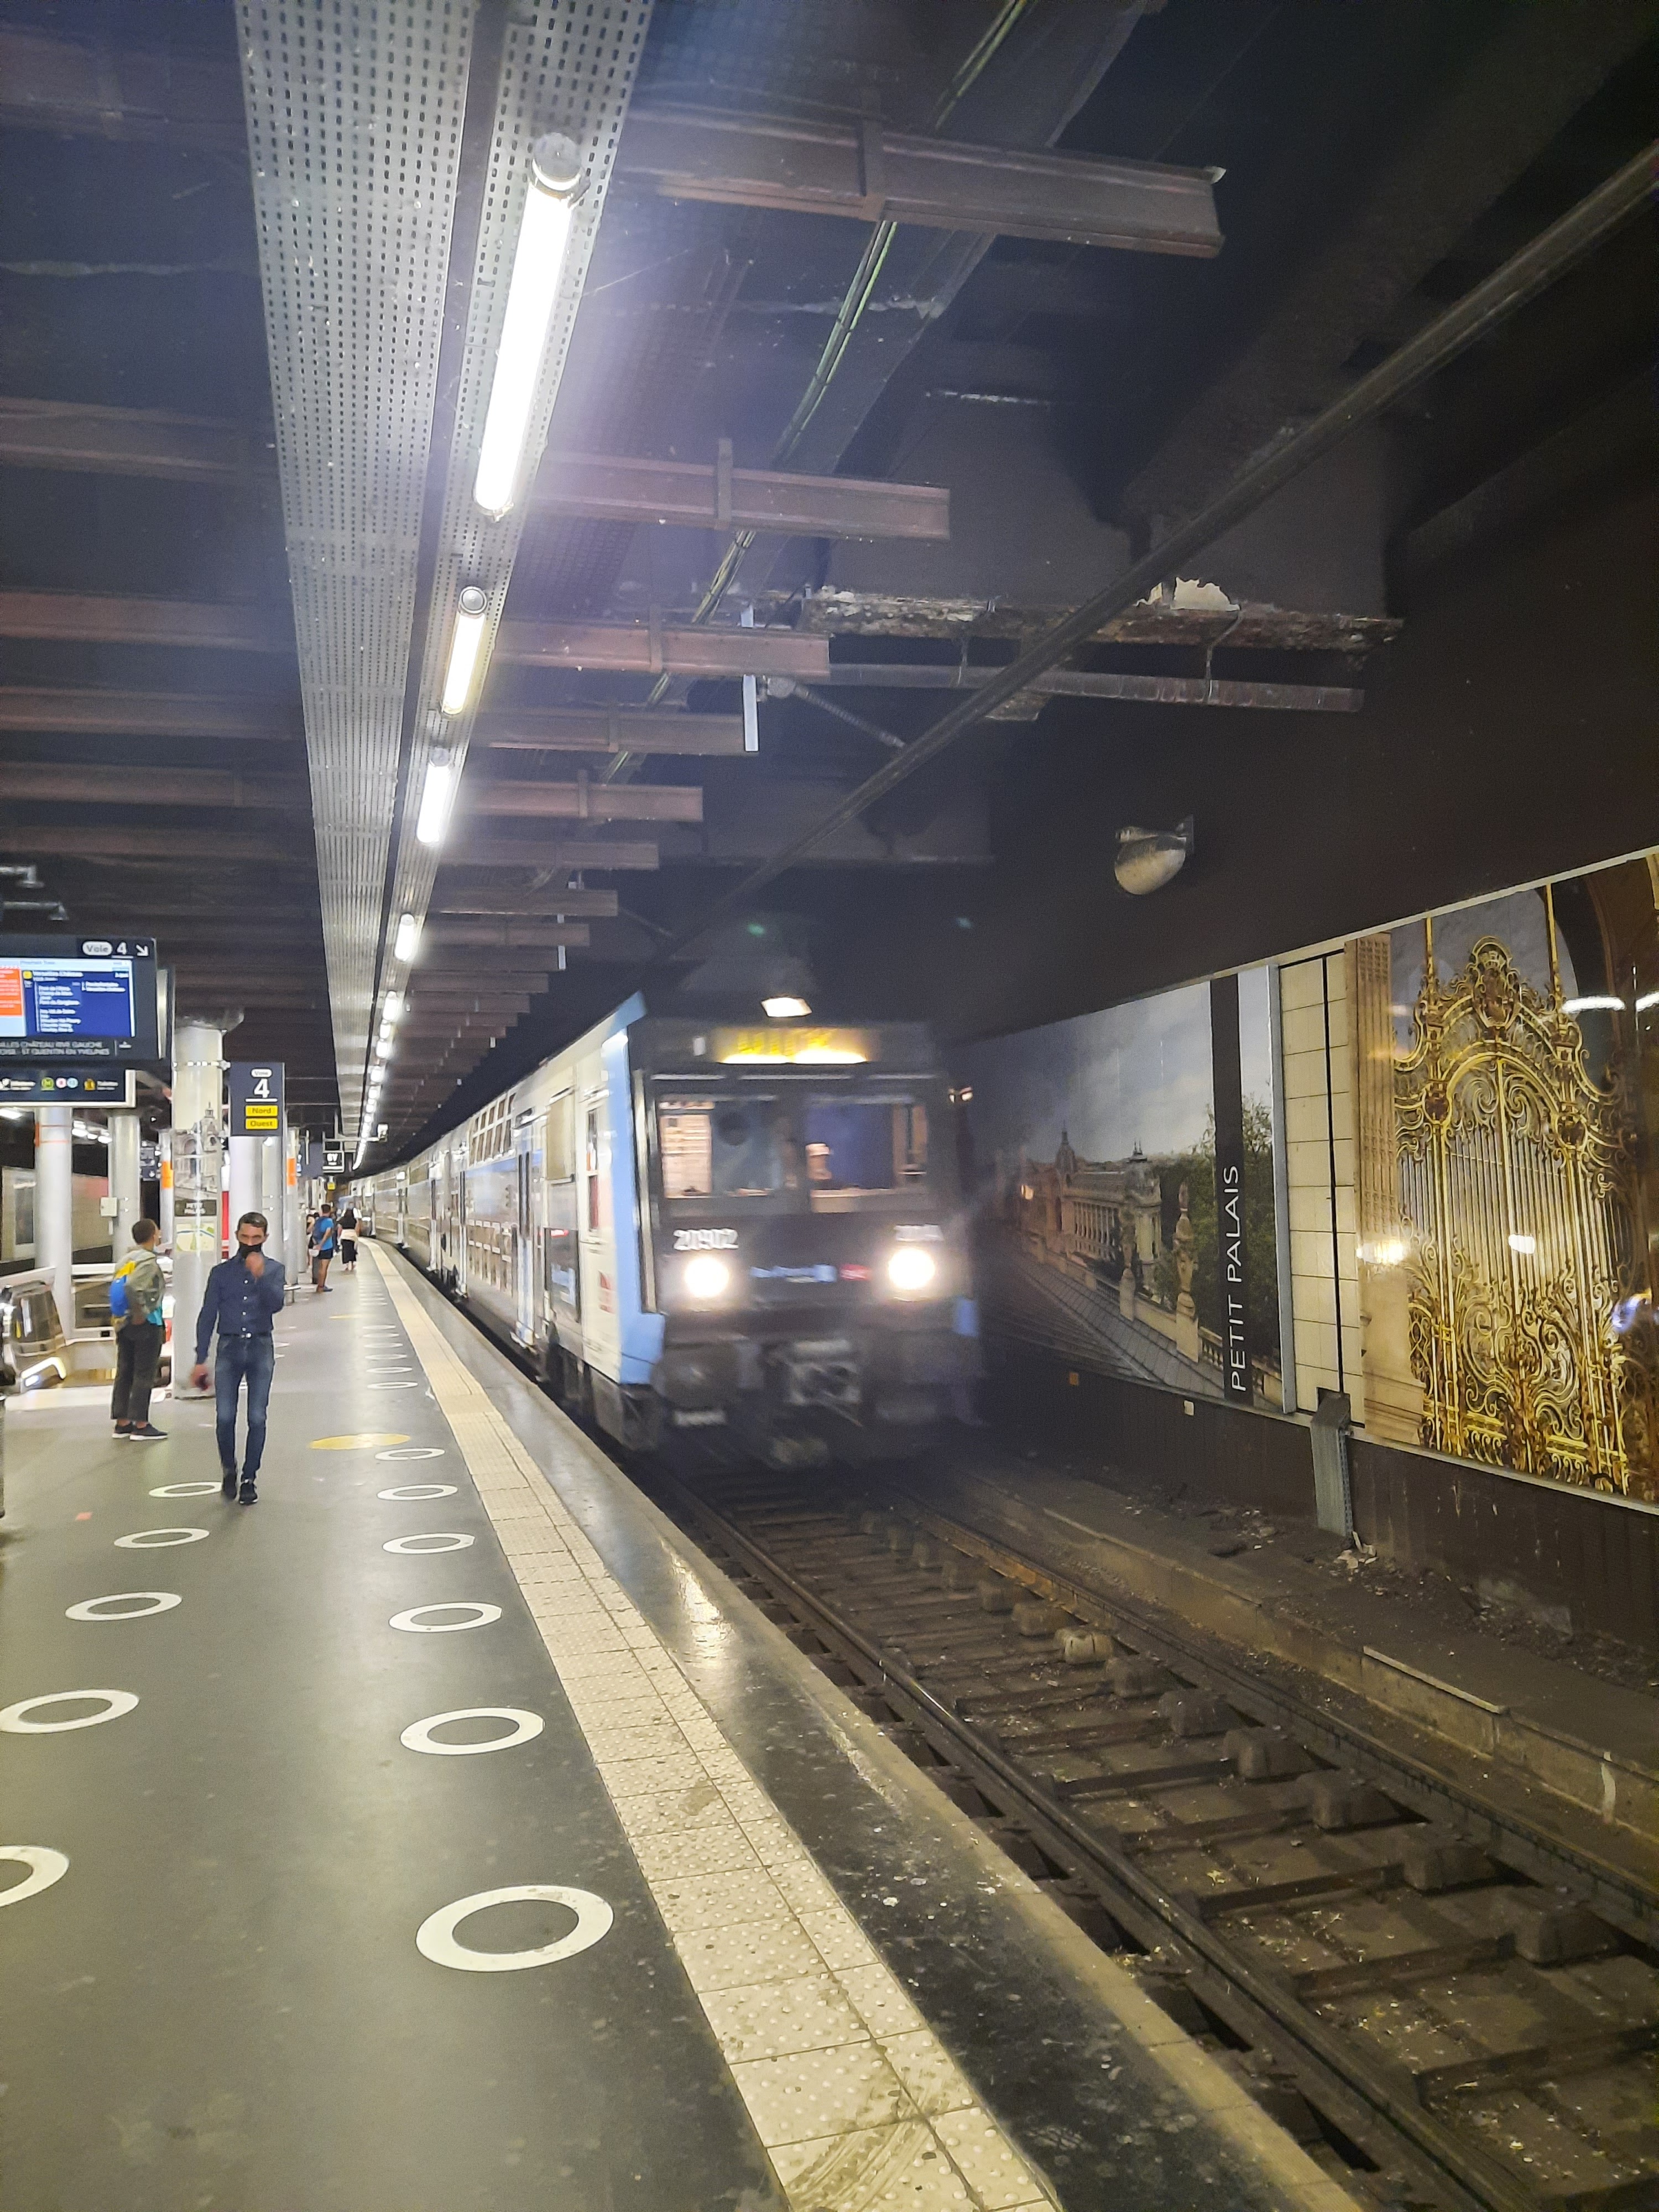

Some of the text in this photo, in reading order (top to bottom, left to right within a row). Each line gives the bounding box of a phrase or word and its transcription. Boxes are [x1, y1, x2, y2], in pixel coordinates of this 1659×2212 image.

[117, 941, 128, 954] 4
[254, 1078, 270, 1099] 4
[1223, 1165, 1247, 1392] PETIT PALAIS
